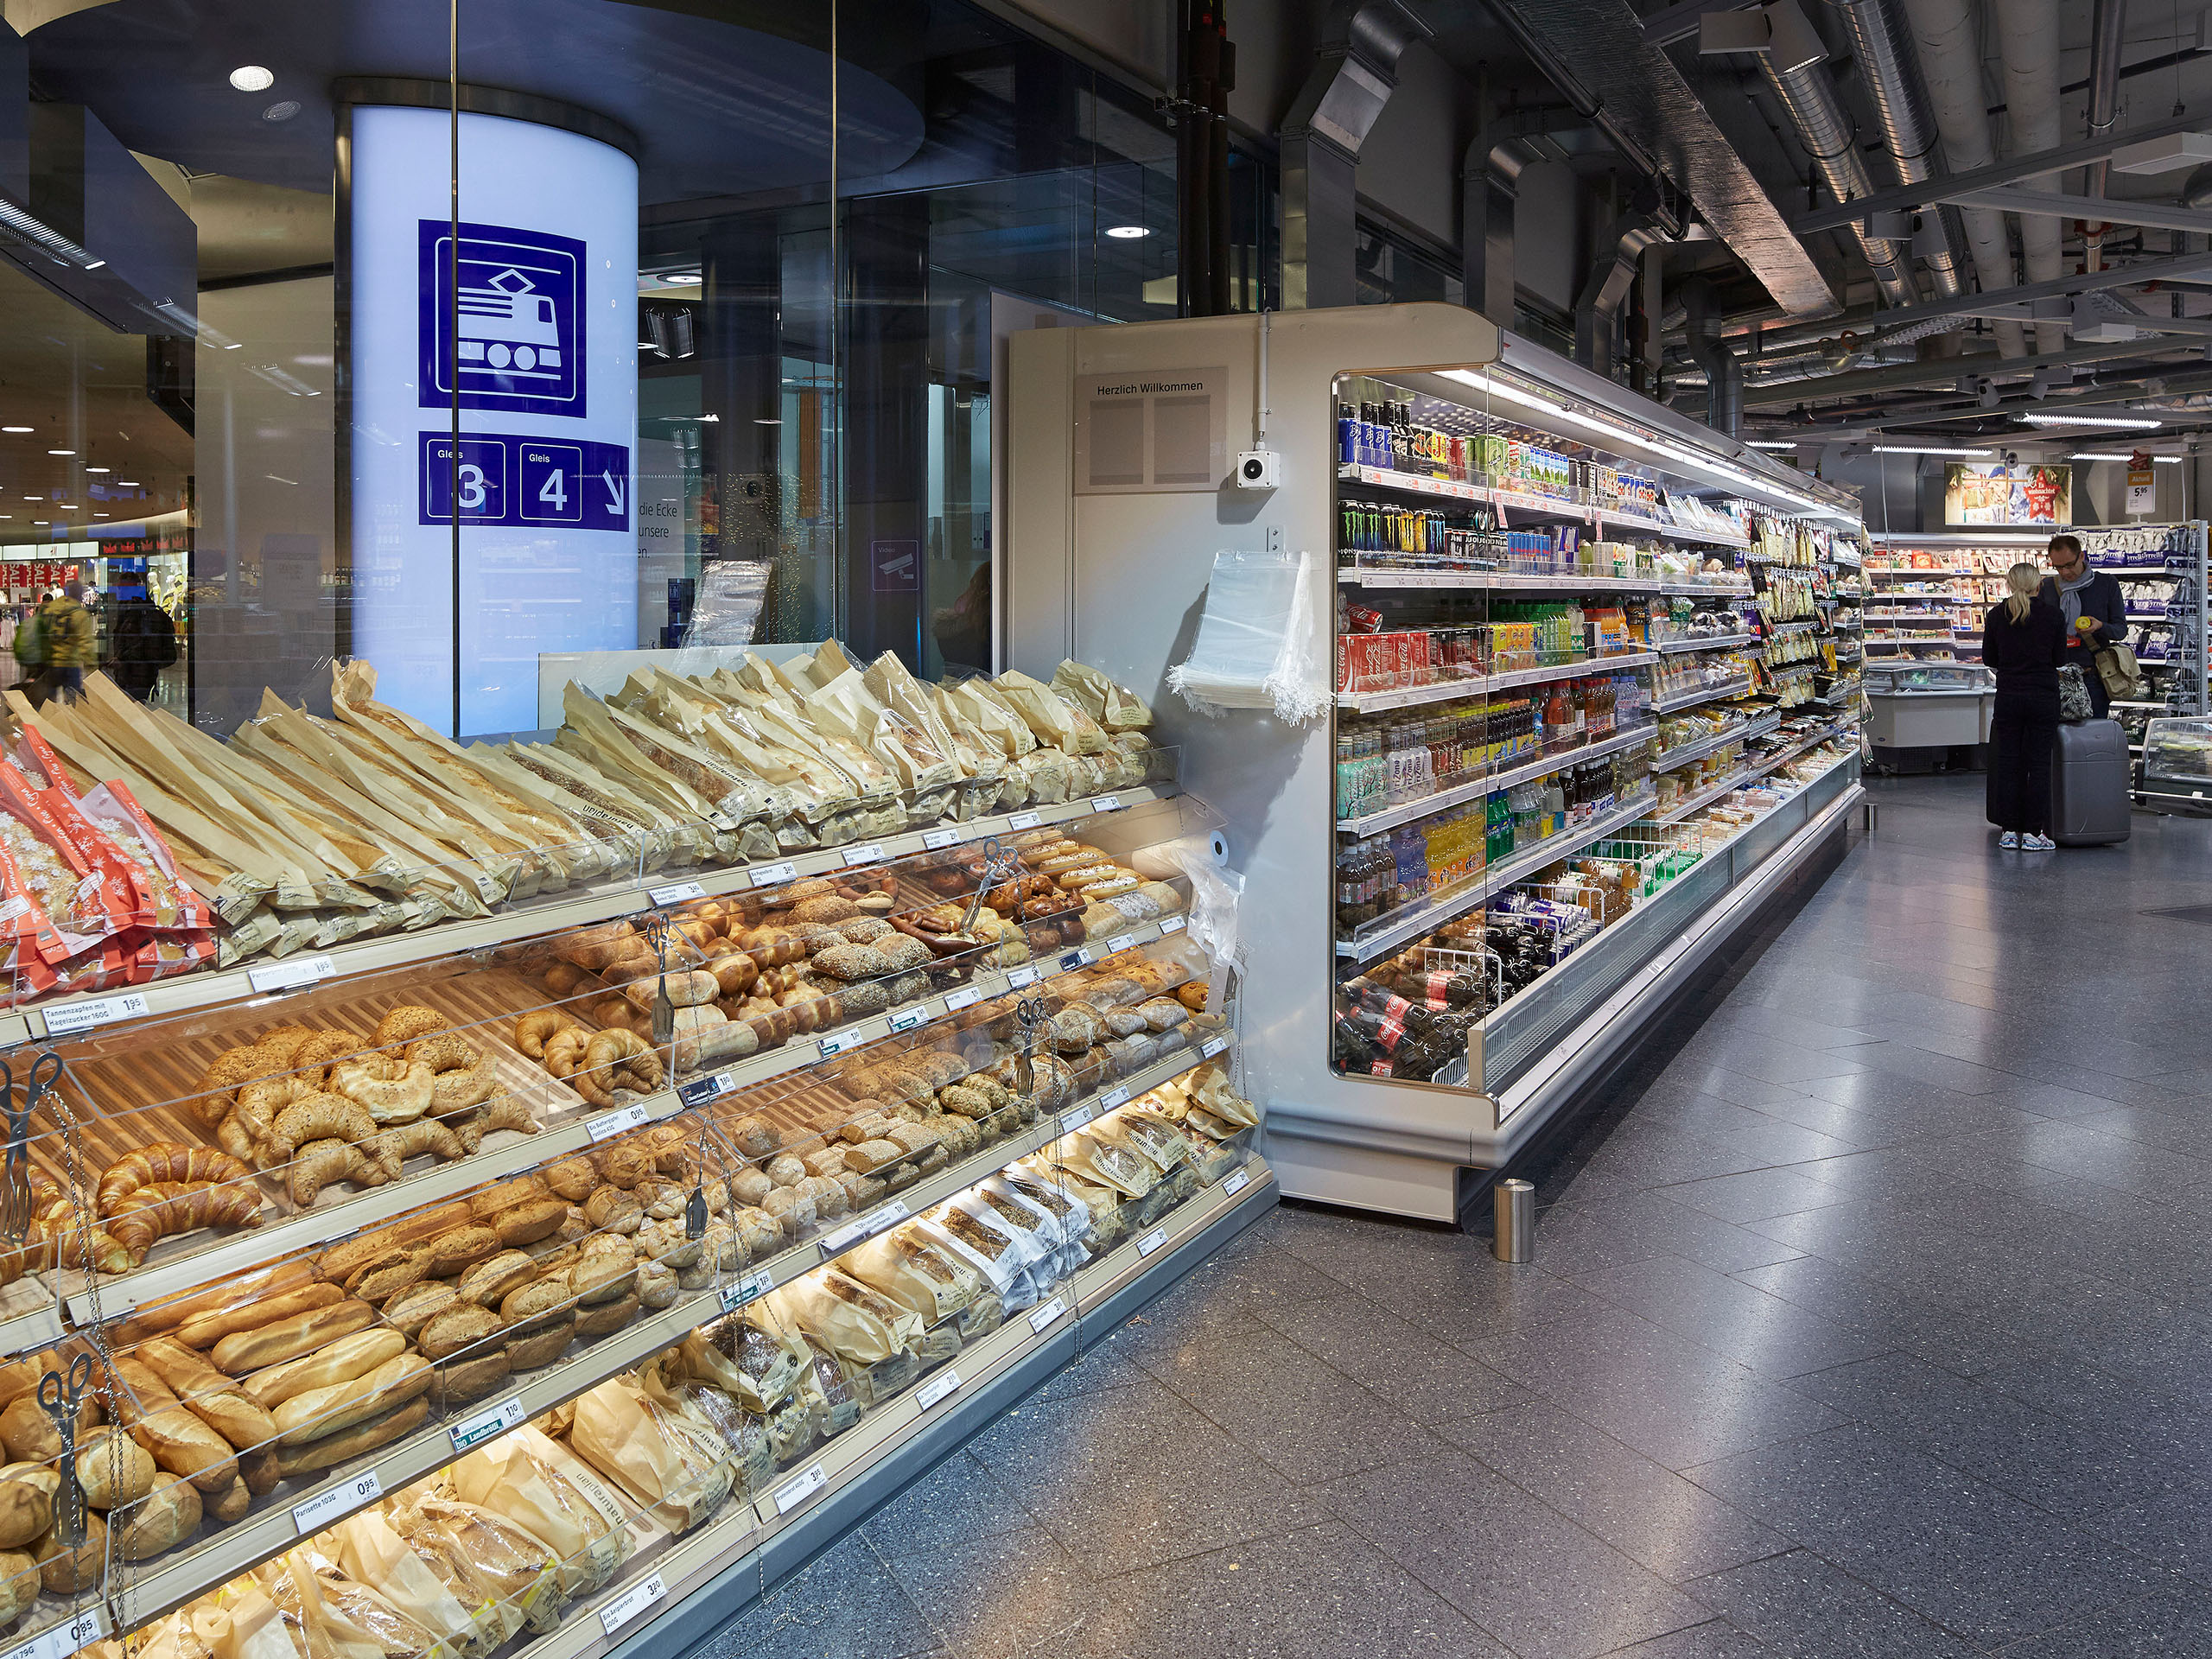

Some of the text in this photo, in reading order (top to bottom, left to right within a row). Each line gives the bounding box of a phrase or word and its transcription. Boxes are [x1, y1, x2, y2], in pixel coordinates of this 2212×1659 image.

[1097, 382, 1203, 395] Herzlich Willkommen
[437, 449, 486, 508] Gles 3
[529, 454, 568, 511] Gleis 4
[639, 502, 677, 517] die Ecke
[638, 527, 670, 538] unsere
[35, 563, 45, 588] SALE
[51, 564, 61, 587] SAL
[65, 565, 74, 583] SAL
[1348, 607, 1368, 620] Cola
[705, 760, 747, 787] naturaplan
[582, 804, 634, 830] naturaplan
[46, 1006, 93, 1018] Tannenzapfen
[123, 998, 141, 1010] 1.95
[1125, 1129, 1159, 1156] naturaplan
[454, 1438, 467, 1450] bio
[468, 1421, 500, 1442] Landbrötli
[296, 1478, 375, 1518] Parisette 103G 0.95
[576, 1472, 623, 1526] naturaplan
[19, 1645, 35, 1659] 79G
